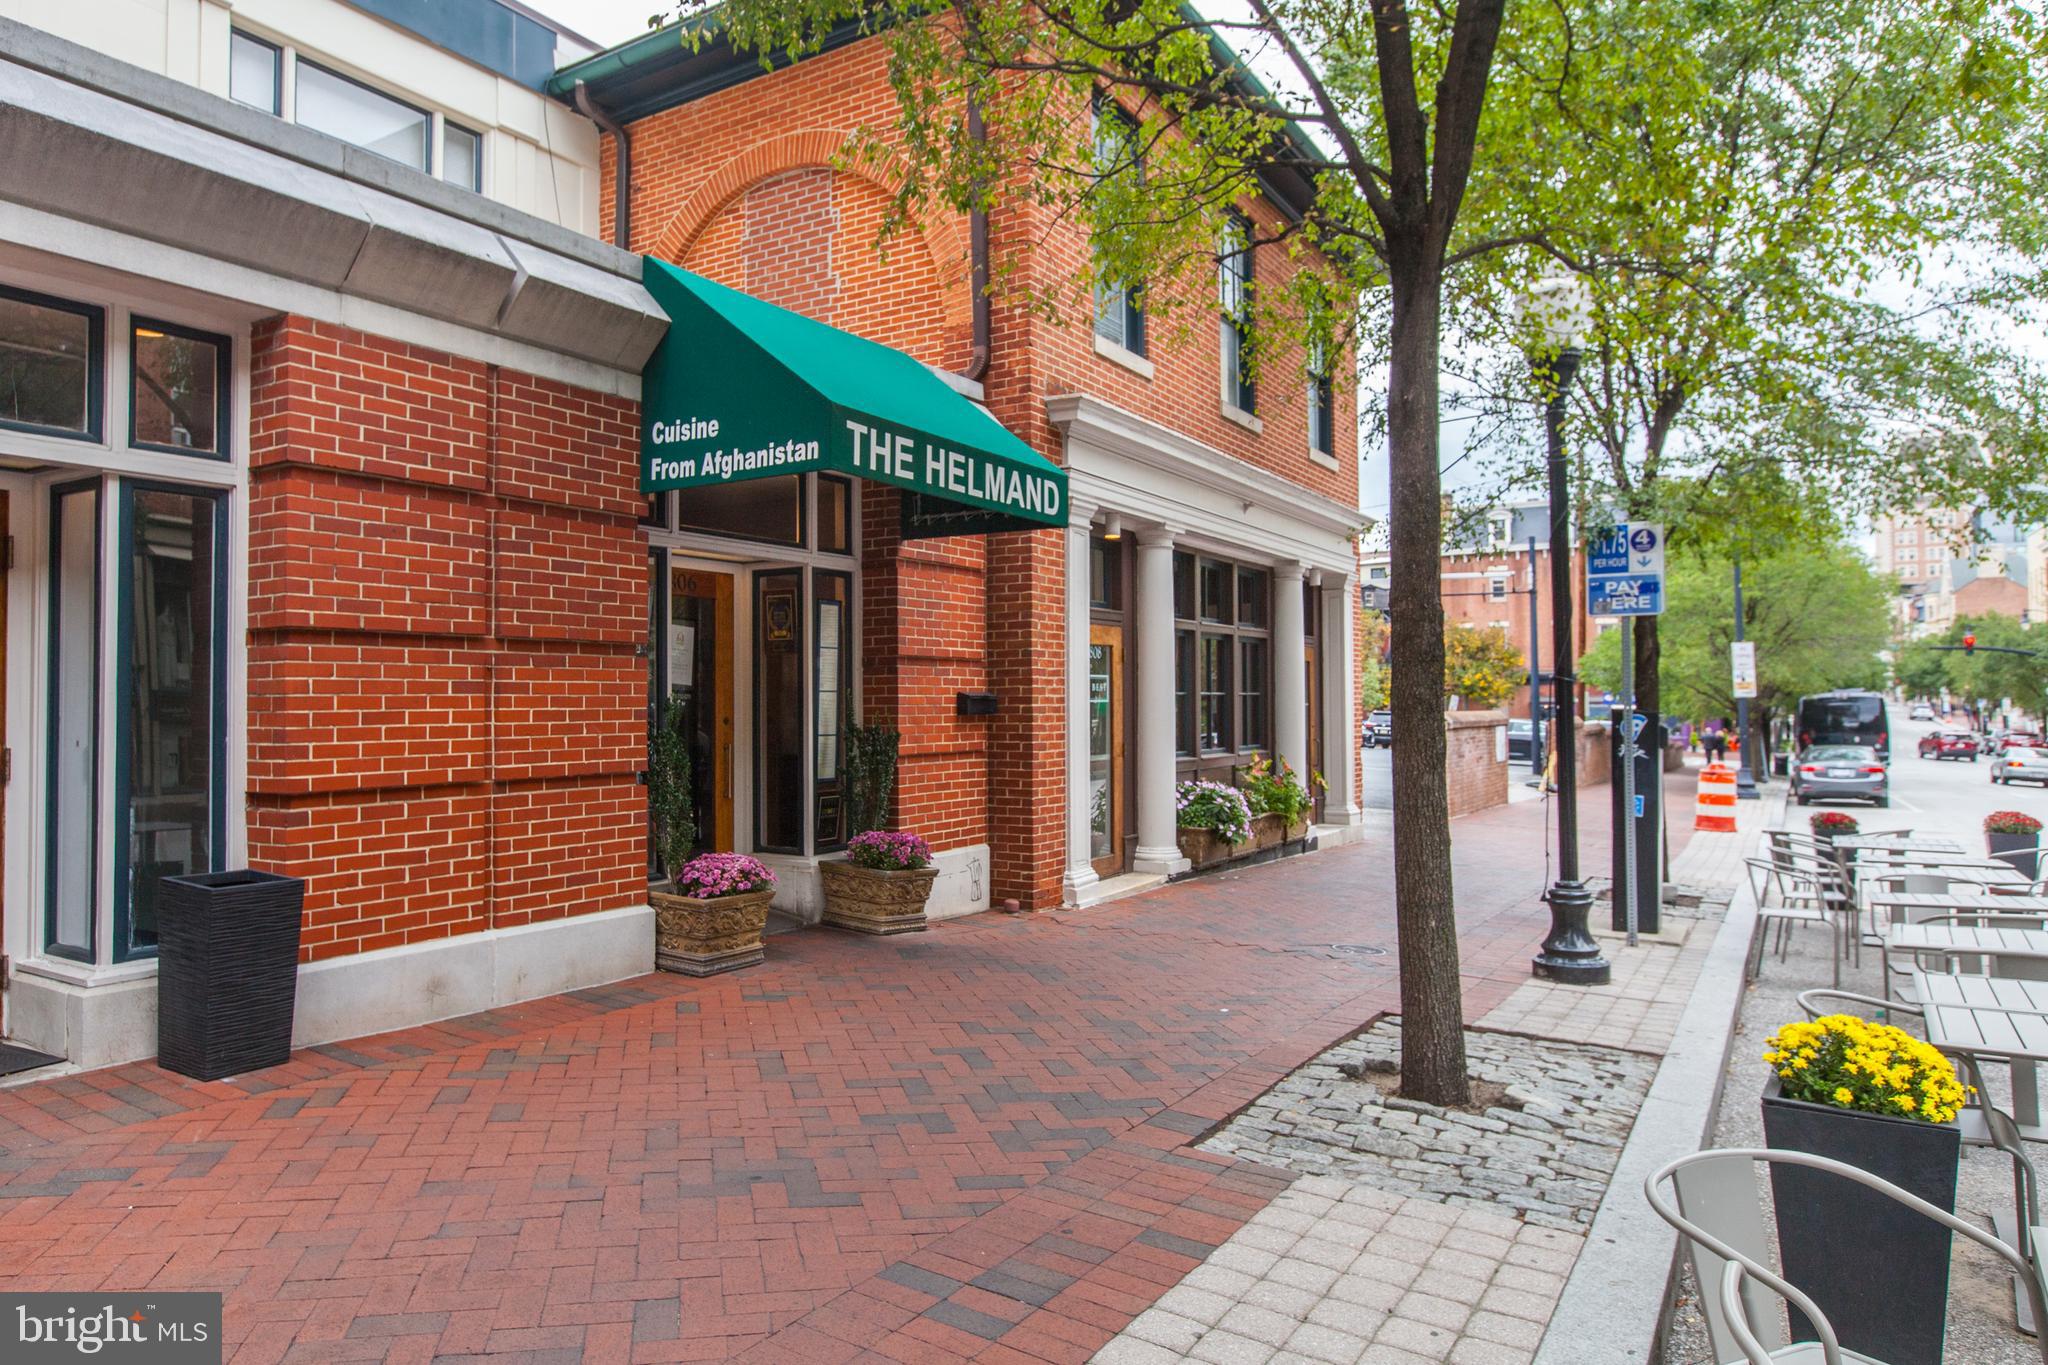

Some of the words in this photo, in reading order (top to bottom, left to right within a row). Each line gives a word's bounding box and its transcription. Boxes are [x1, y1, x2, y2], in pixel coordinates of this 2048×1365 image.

[652, 417, 719, 445] Cuisine
[651, 458, 695, 480] From
[701, 439, 819, 479] Afghanistan
[846, 420, 914, 480] THE
[926, 444, 1060, 516] HELMAND
[1635, 530, 1650, 544] 4
[1593, 559, 1607, 568] PER
[1607, 557, 1627, 567] HOUR
[1605, 580, 1643, 596] PAY
